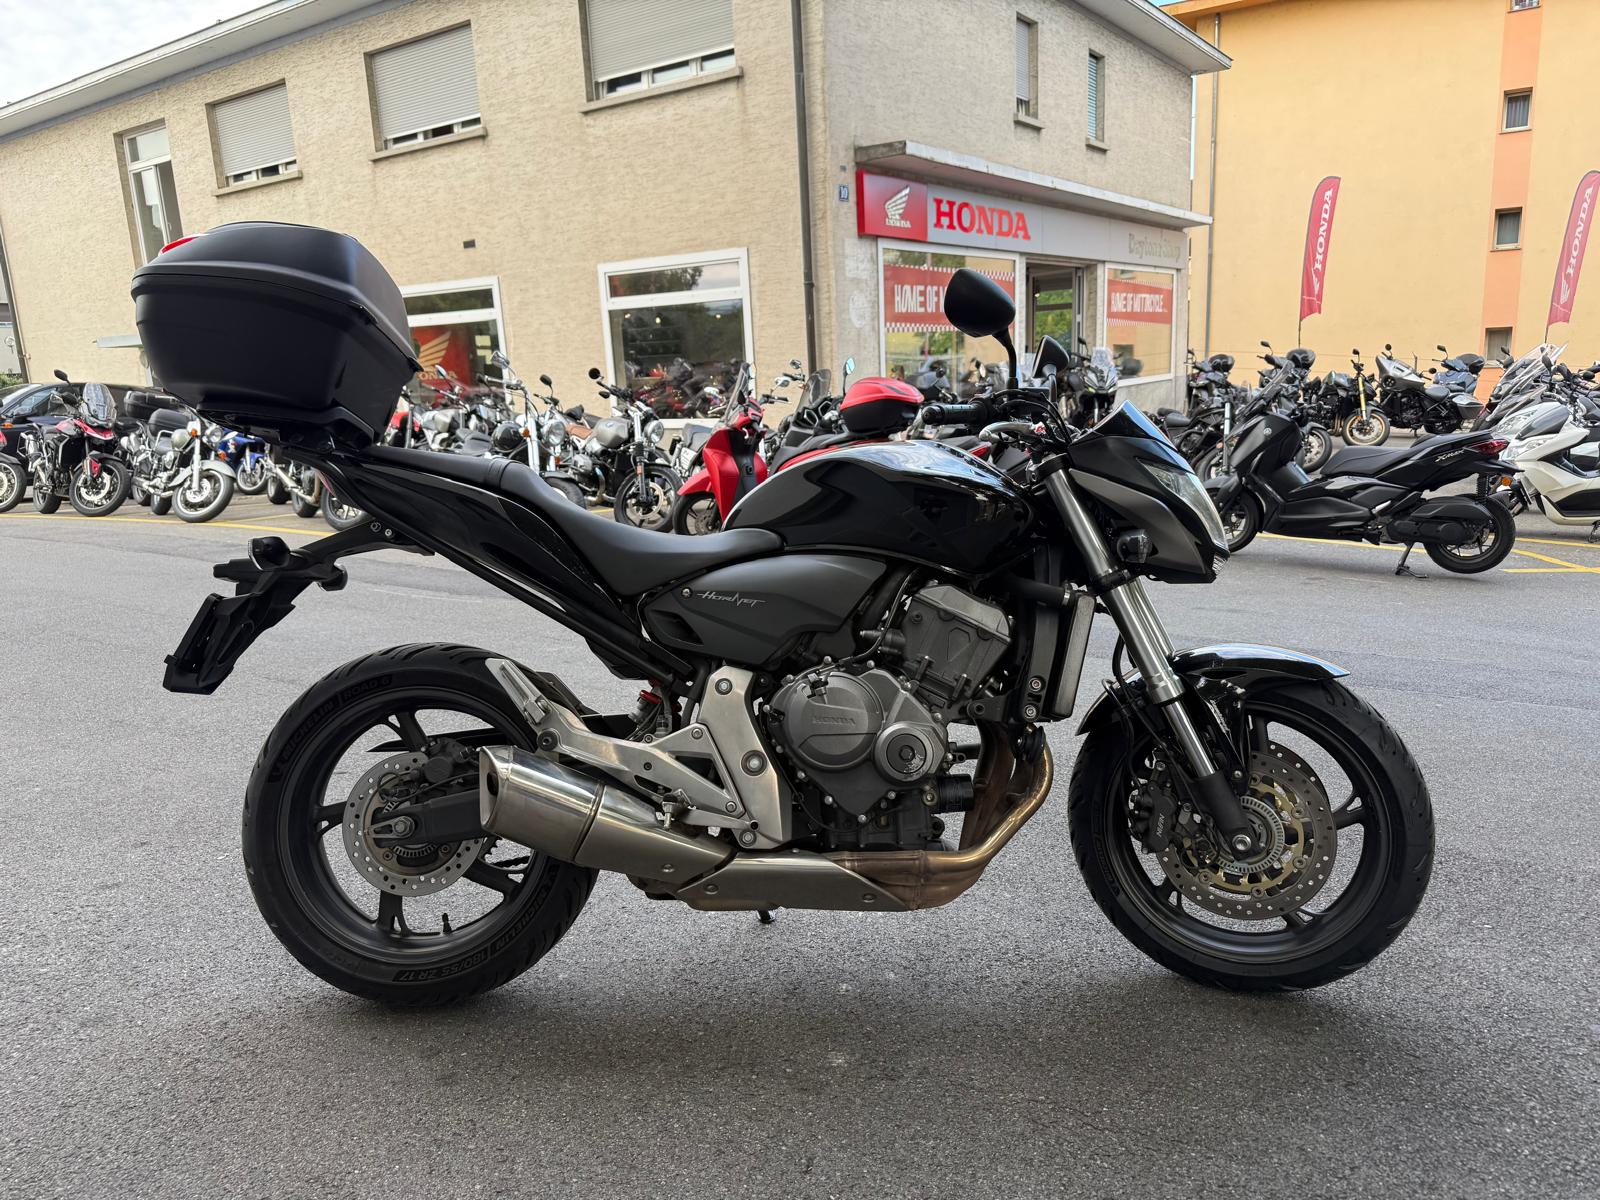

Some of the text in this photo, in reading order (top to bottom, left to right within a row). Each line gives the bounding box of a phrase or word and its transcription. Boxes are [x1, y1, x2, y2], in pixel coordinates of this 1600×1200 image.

[885, 218, 912, 229] HONDA
[933, 197, 1031, 240] HONDA
[1313, 188, 1333, 272] HONDA
[1566, 185, 1594, 277] HONDA
[894, 284, 925, 313] HOME
[926, 285, 938, 313] OF
[343, 679, 380, 703] ROAD
[812, 715, 857, 727] HONDA
